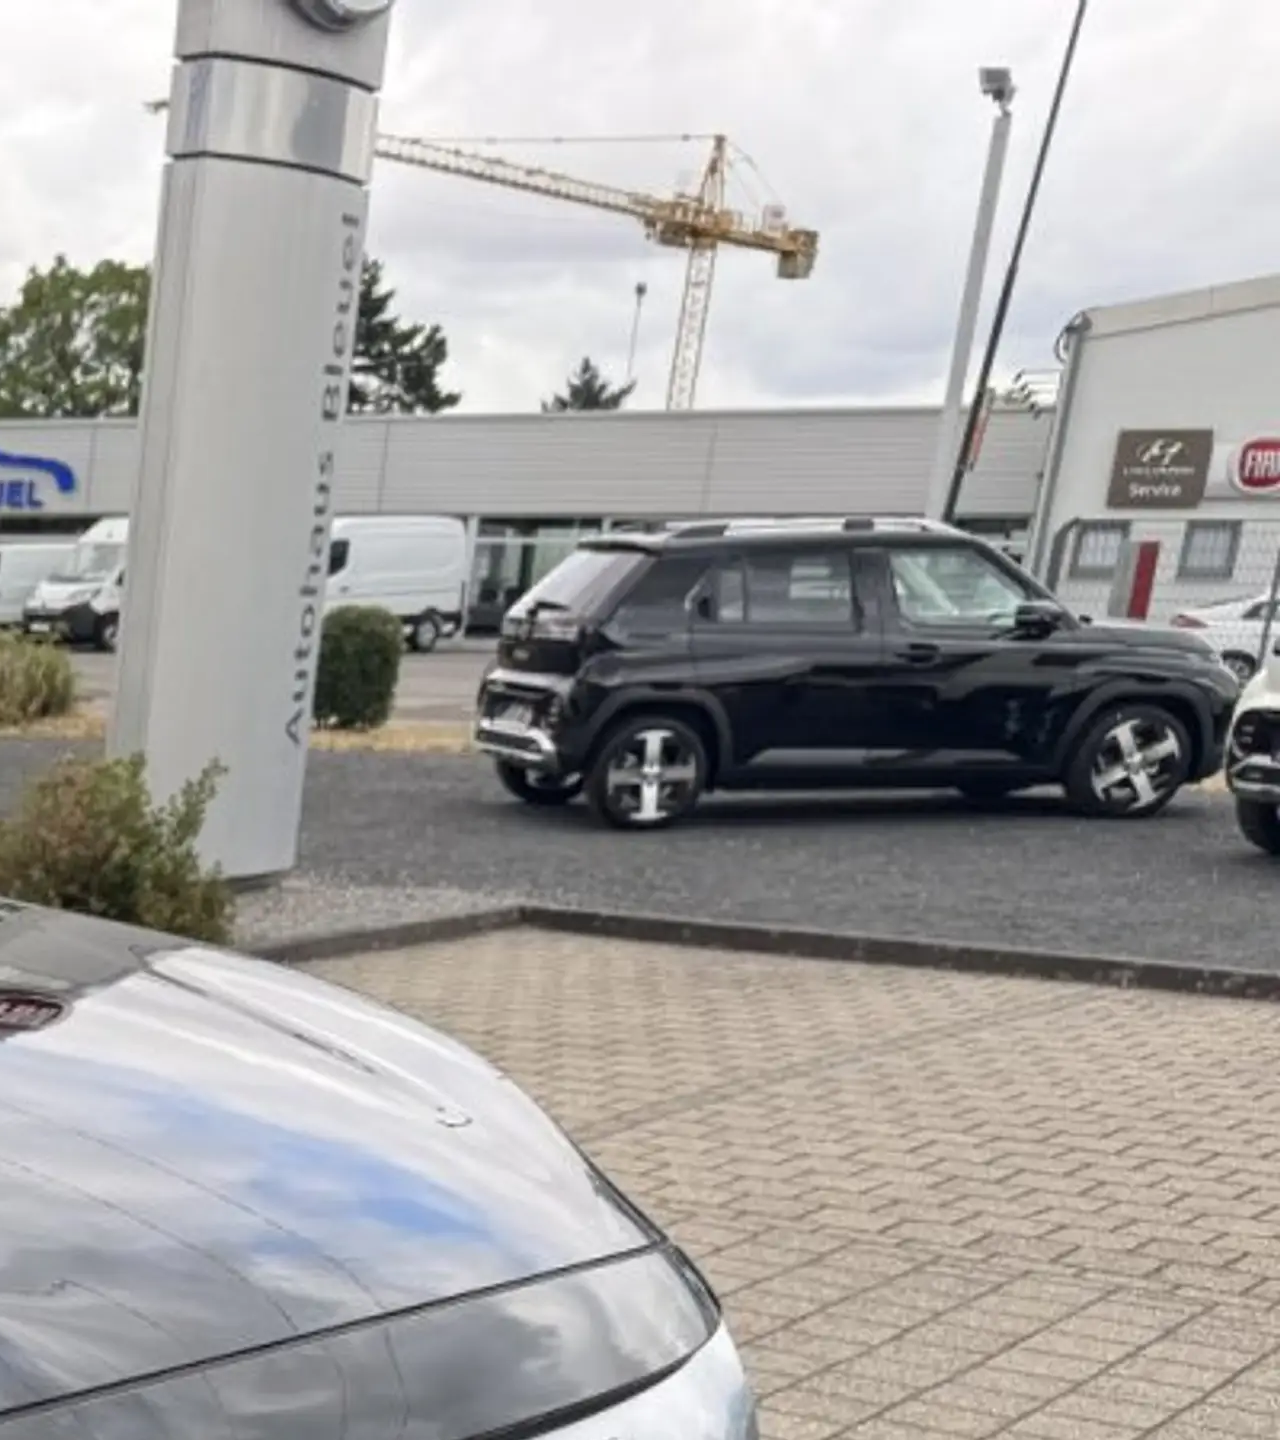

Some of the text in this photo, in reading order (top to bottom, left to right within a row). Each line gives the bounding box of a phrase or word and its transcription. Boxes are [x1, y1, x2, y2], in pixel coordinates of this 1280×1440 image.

[285, 212, 360, 745] Autohaus Bleuel
[1129, 482, 1182, 498] Service
